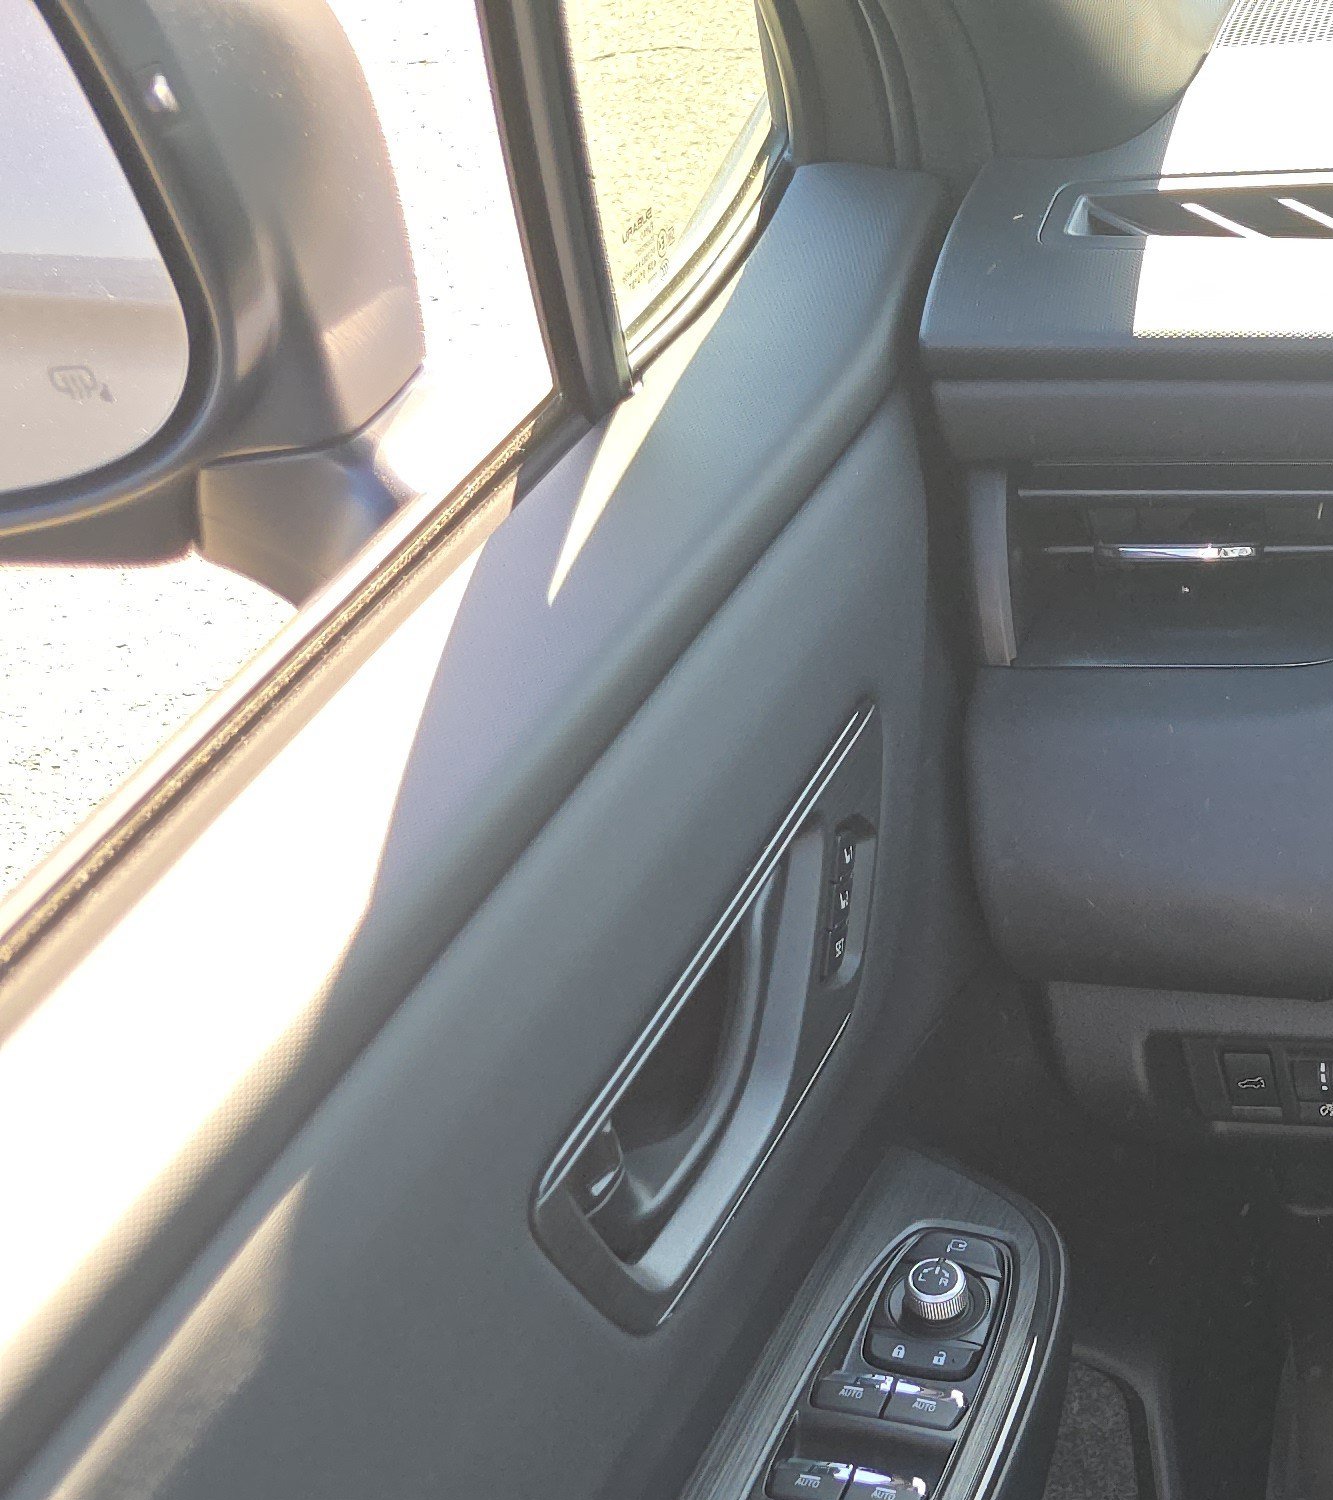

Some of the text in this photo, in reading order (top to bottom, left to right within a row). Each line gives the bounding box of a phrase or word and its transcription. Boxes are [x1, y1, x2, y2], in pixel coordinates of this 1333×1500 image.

[839, 1388, 864, 1399] AUTO
[912, 1401, 937, 1412] AUTO
[795, 1477, 821, 1488] AUTO
[871, 1490, 896, 1500] AUTO
